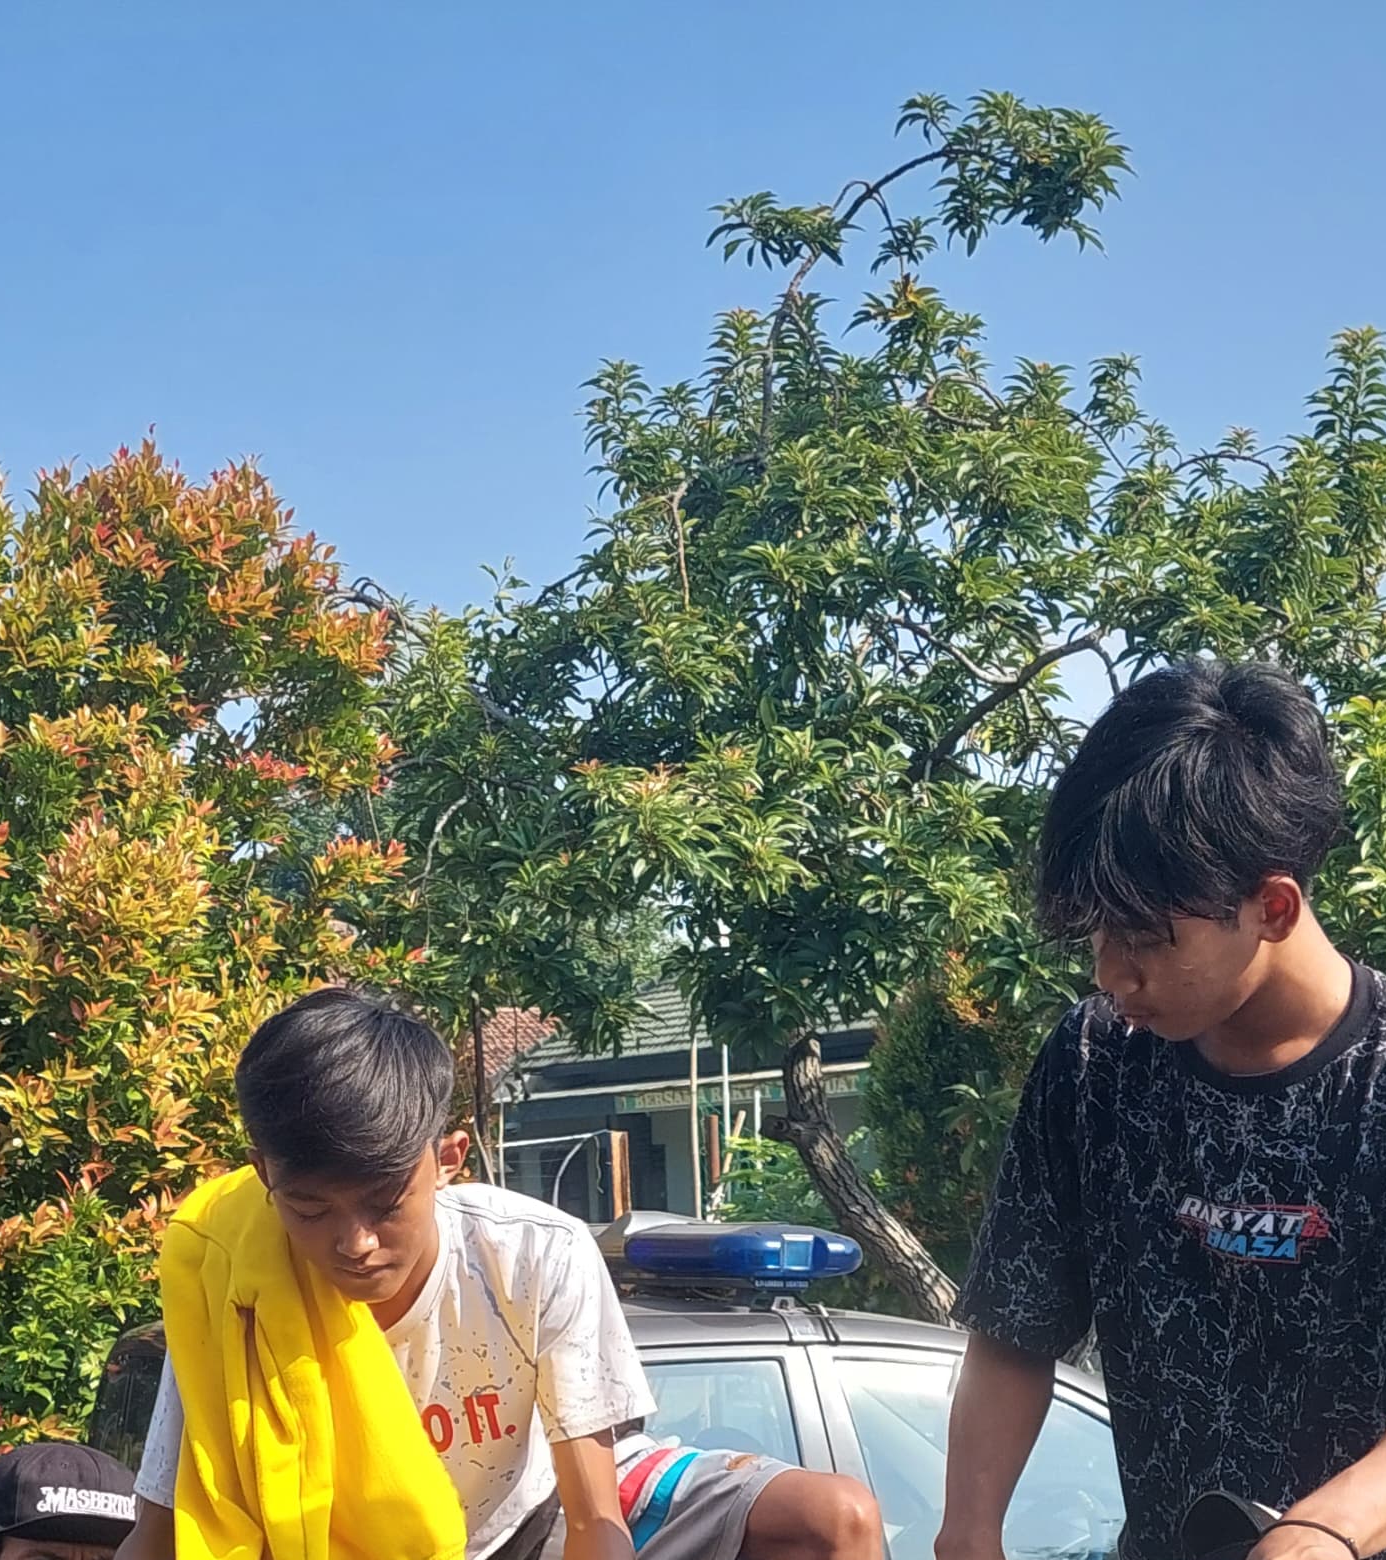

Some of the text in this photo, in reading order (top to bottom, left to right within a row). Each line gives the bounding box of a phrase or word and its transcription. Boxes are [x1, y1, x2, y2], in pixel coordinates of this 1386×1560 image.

[1206, 1229, 1297, 1260] BIASA
[421, 1392, 517, 1453] O IT.
